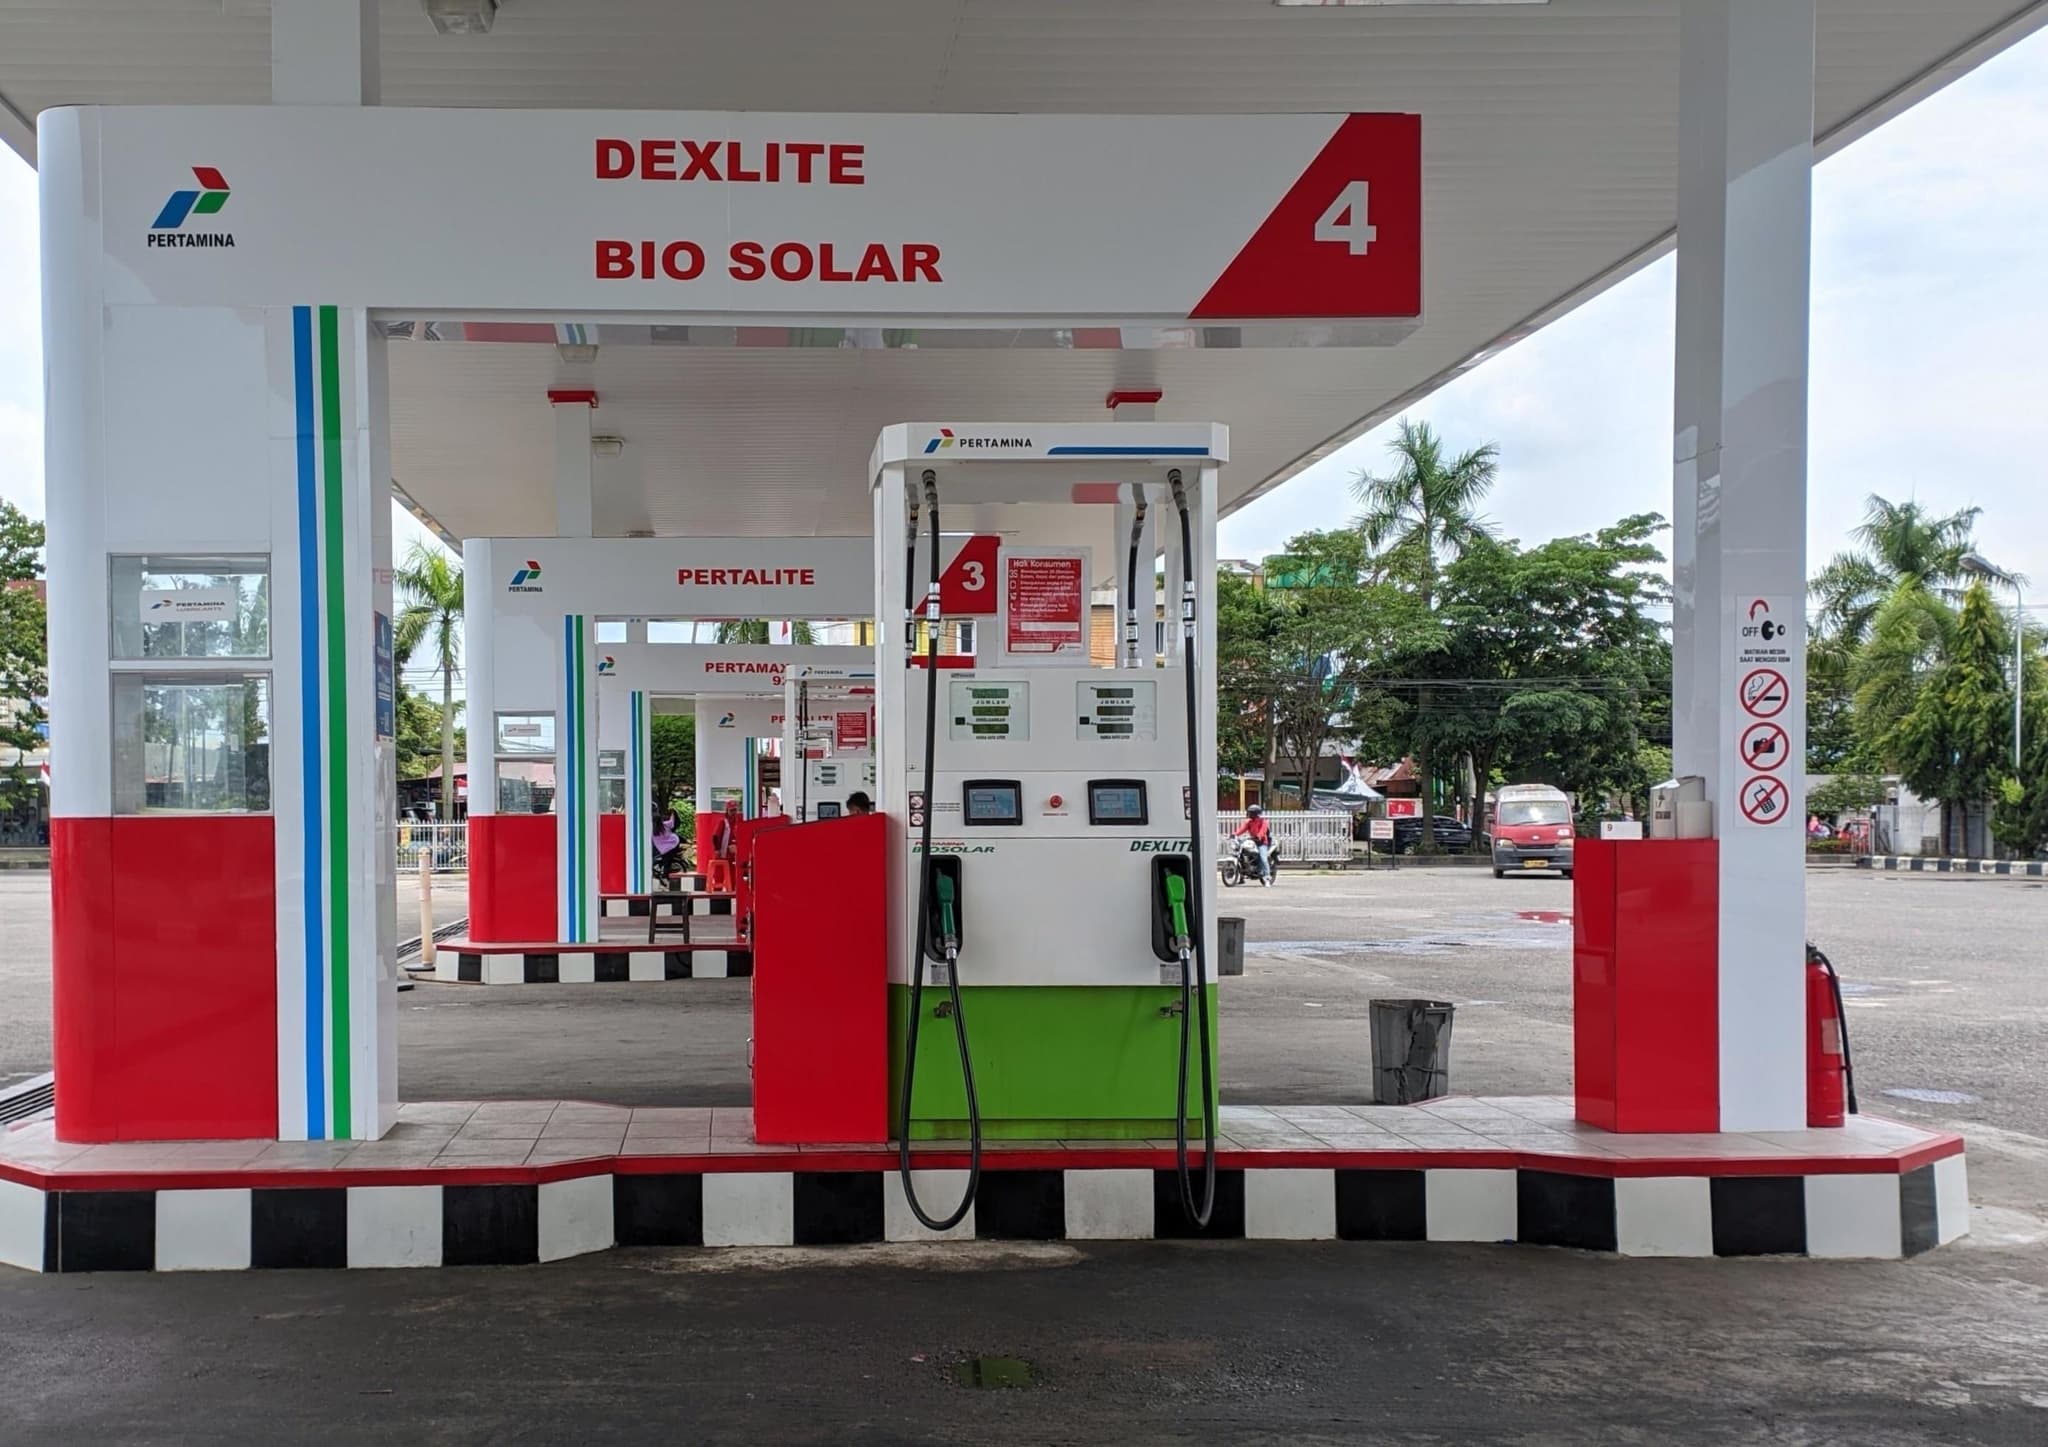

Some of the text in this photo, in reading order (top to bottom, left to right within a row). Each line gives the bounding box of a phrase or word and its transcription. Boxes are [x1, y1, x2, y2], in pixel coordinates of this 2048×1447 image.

[596, 139, 865, 184] DEXLITE
[1314, 181, 1377, 255] 4
[147, 233, 235, 247] PERTAMINA
[596, 240, 943, 283] BIO SOLAR
[959, 438, 1033, 448] PERTAMINA
[678, 568, 815, 586] PERTALITE
[962, 560, 986, 591] 3
[1742, 626, 1759, 637] OFF
[772, 675, 785, 686] 9
